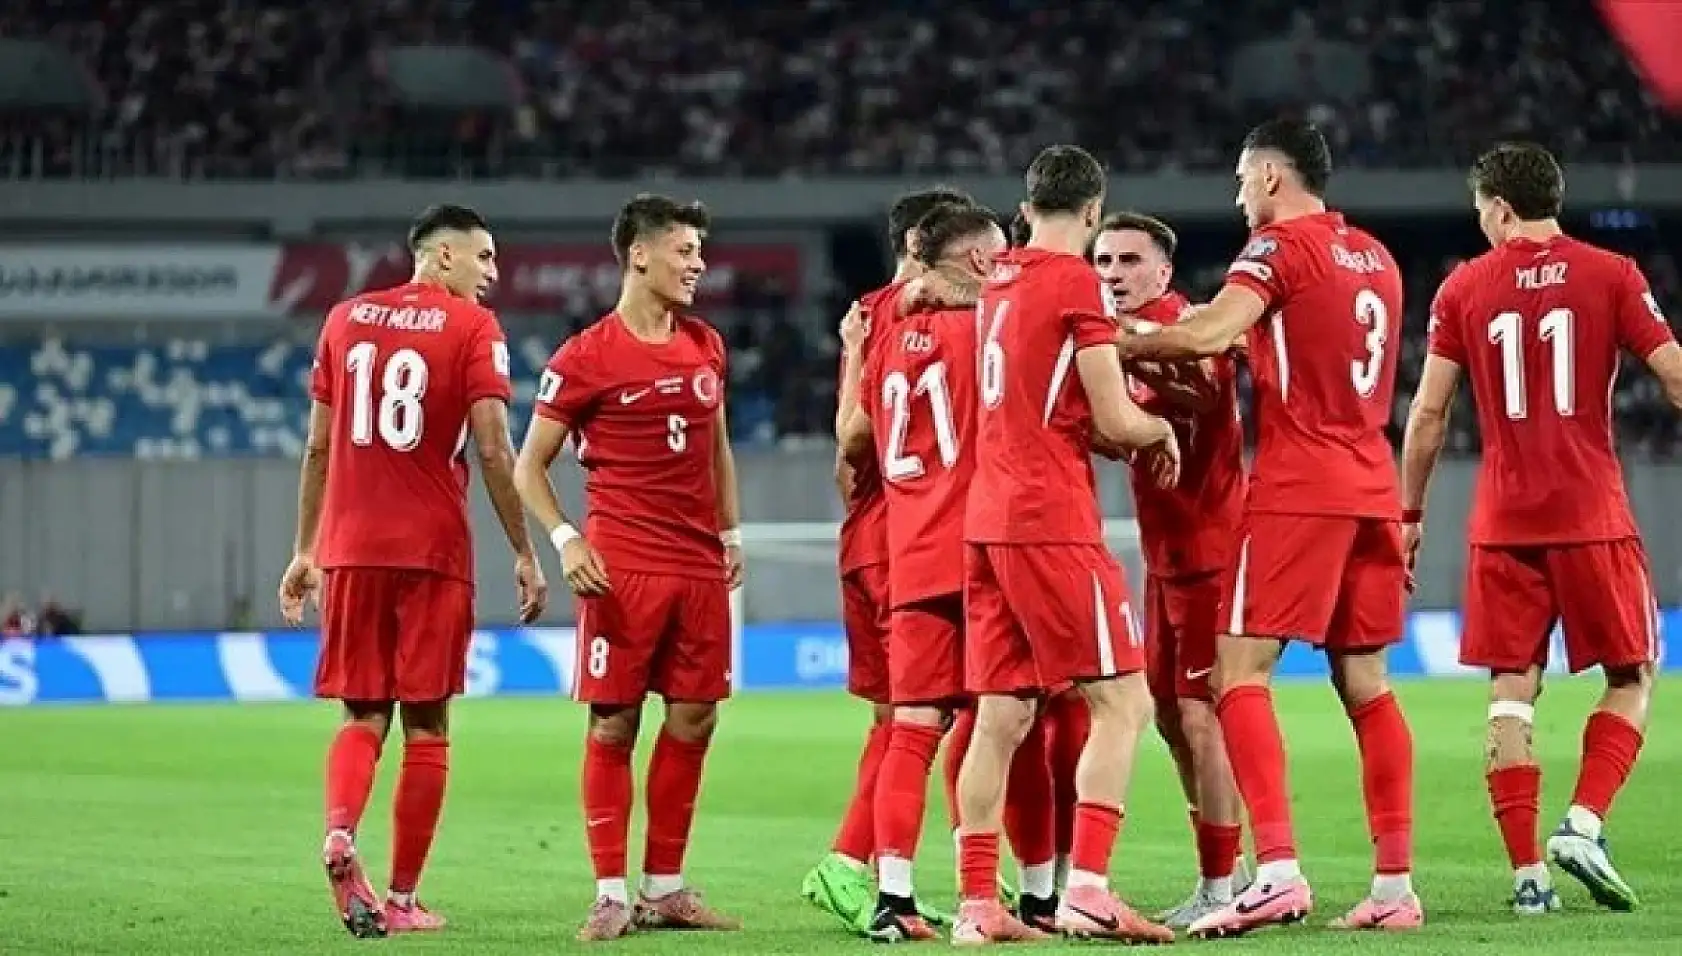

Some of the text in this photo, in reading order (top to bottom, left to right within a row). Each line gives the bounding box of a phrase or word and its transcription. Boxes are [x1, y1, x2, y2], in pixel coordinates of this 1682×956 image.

[349, 302, 389, 328] MERT
[1515, 261, 1568, 289] YILDIZ
[347, 342, 429, 452] 18
[1352, 289, 1387, 399] 3
[1488, 308, 1576, 419] 11
[882, 361, 960, 482] 21
[588, 636, 609, 679] 8
